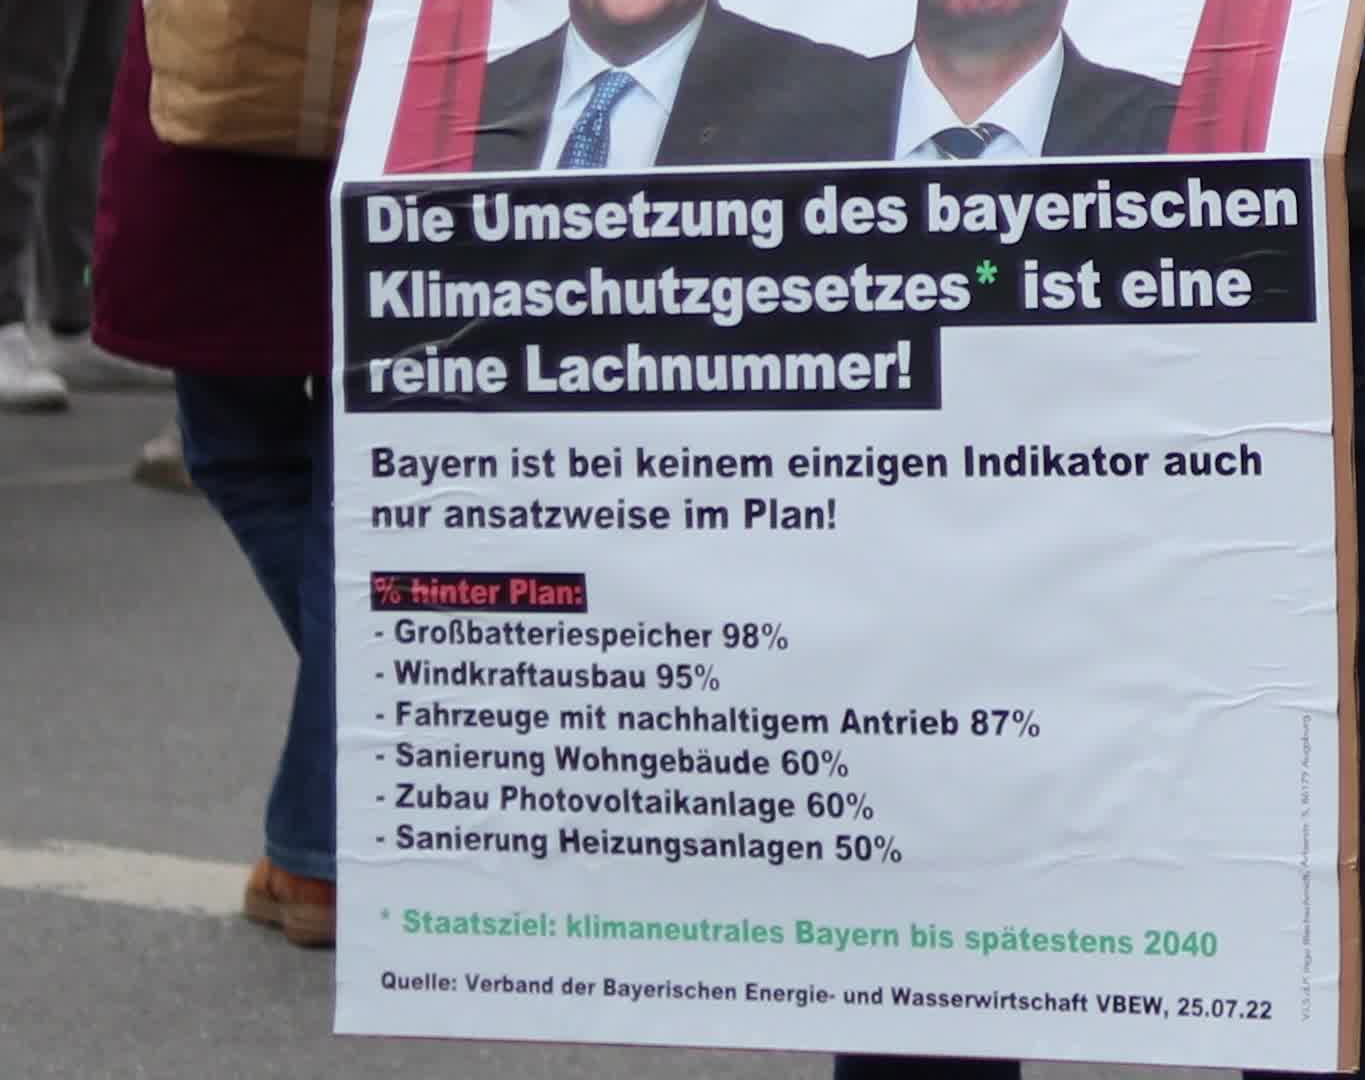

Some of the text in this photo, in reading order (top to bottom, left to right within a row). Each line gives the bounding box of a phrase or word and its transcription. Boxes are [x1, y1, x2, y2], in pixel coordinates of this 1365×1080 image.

[367, 178, 1297, 248] Die Umsetzung des bayerischen
[1025, 260, 1101, 309] ist
[1122, 261, 1251, 308] eine
[369, 340, 910, 393] reine Lachnummer!
[372, 444, 1261, 486] Bayern ist bei keinem einzigen Indikator auch
[372, 498, 835, 531] nur ansatzweise im Plan!
[372, 576, 583, 608] % hinter Plan:
[395, 619, 712, 652] Großbatteriespeicher
[723, 623, 788, 649] 98%
[394, 660, 645, 688] Windkraftausbau
[656, 664, 719, 690] 95%
[397, 701, 549, 735] Fahrzeuge
[560, 705, 605, 730] mit
[619, 706, 828, 740] nachhaltigem
[841, 709, 958, 738] Antrieb
[971, 710, 1039, 737] 87%
[396, 745, 544, 776] Sanierung
[555, 746, 769, 779] Wohngebäude
[782, 750, 848, 777] 60%
[396, 784, 488, 815] Zubau
[501, 786, 795, 823] Photovoltaikanlage
[808, 792, 873, 819] 60%
[397, 828, 547, 859] Sanierung
[560, 829, 822, 866] Heizungsanlagen
[836, 835, 901, 862] 50%
[402, 908, 556, 944] Staatsziel:
[566, 915, 784, 946] klimaneutrales
[795, 920, 897, 951] Bayern
[911, 923, 955, 952] bis
[966, 925, 1133, 959] spätestens
[1144, 929, 1216, 959] 2040
[381, 972, 1271, 1019] Quelle: Verband der Bayerischen Energie- und Wasserwirtschaft VBEW, 25.07.22
